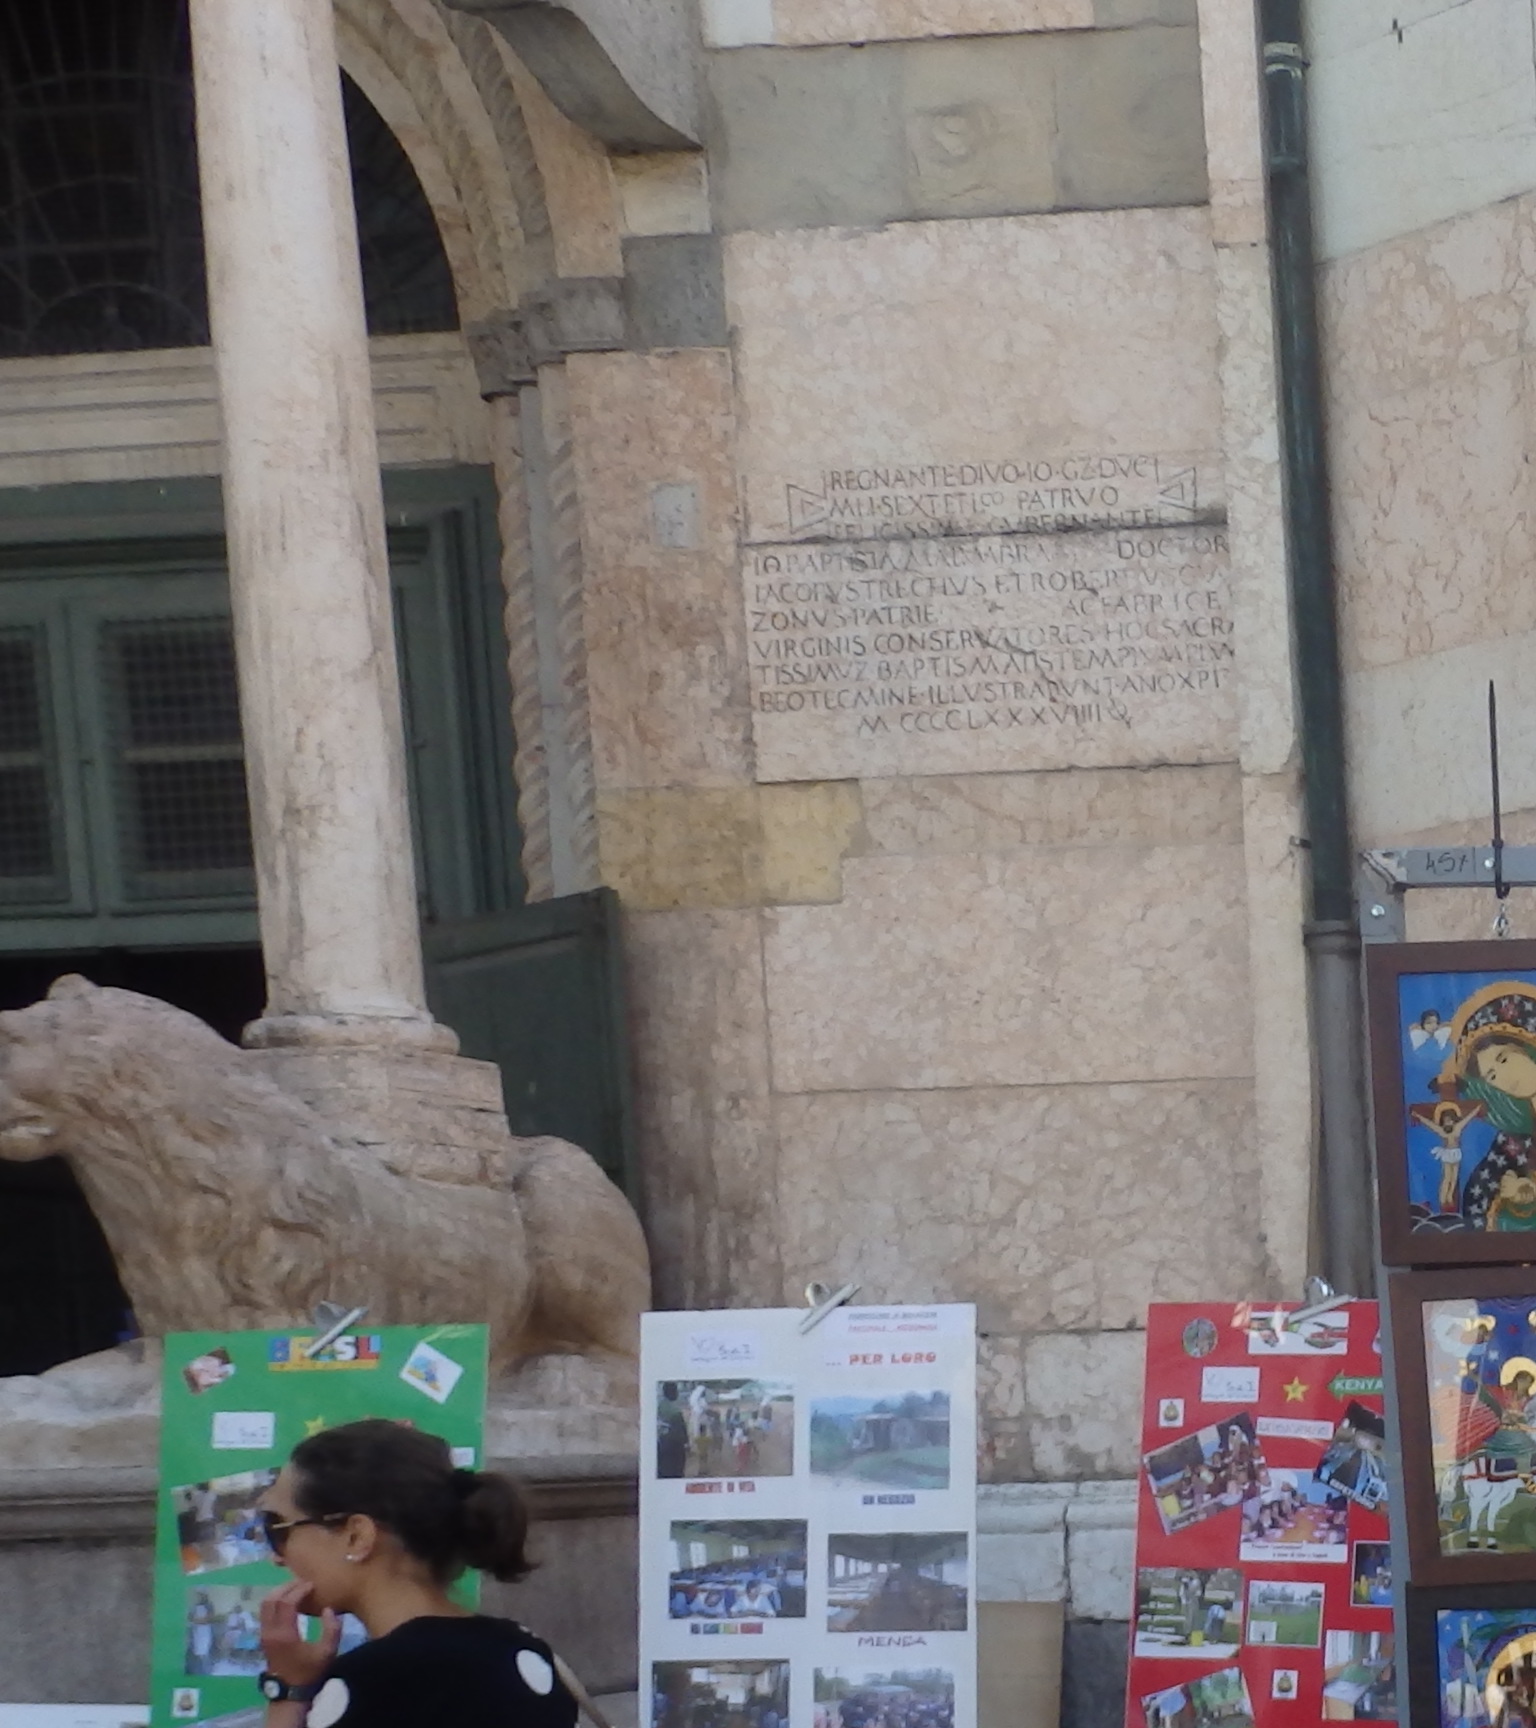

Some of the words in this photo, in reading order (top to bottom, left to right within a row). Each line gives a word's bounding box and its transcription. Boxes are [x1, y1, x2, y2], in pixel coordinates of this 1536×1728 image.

[754, 635, 867, 660] VIRGINIS
[849, 1353, 883, 1366] PER
[890, 1351, 937, 1365] LORO
